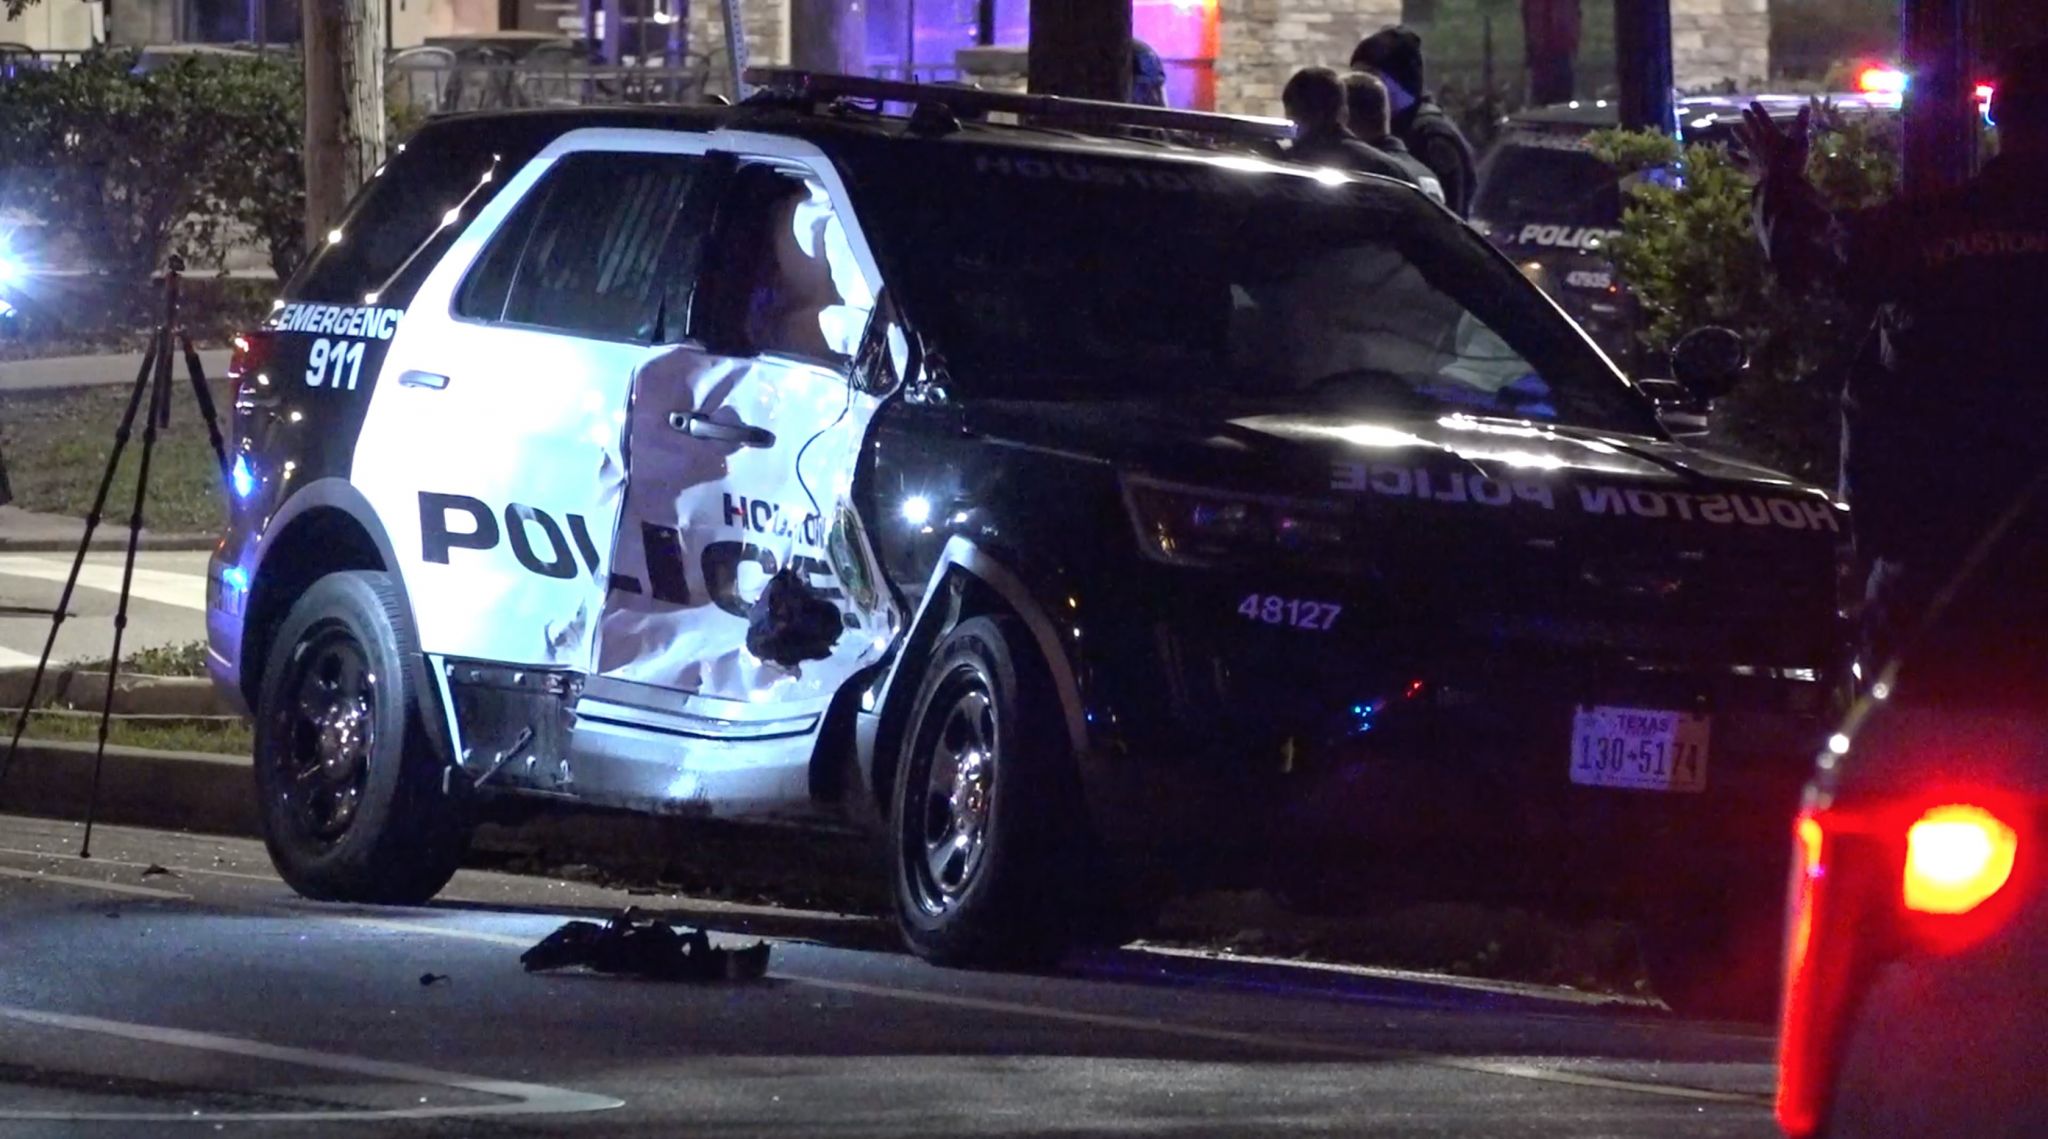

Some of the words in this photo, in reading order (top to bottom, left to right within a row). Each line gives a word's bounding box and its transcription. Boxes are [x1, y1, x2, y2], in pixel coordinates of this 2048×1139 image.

[305, 337, 366, 390] 911
[722, 493, 827, 550] HOON
[1237, 593, 1342, 631] 48127
[1616, 714, 1670, 733] TEXAS
